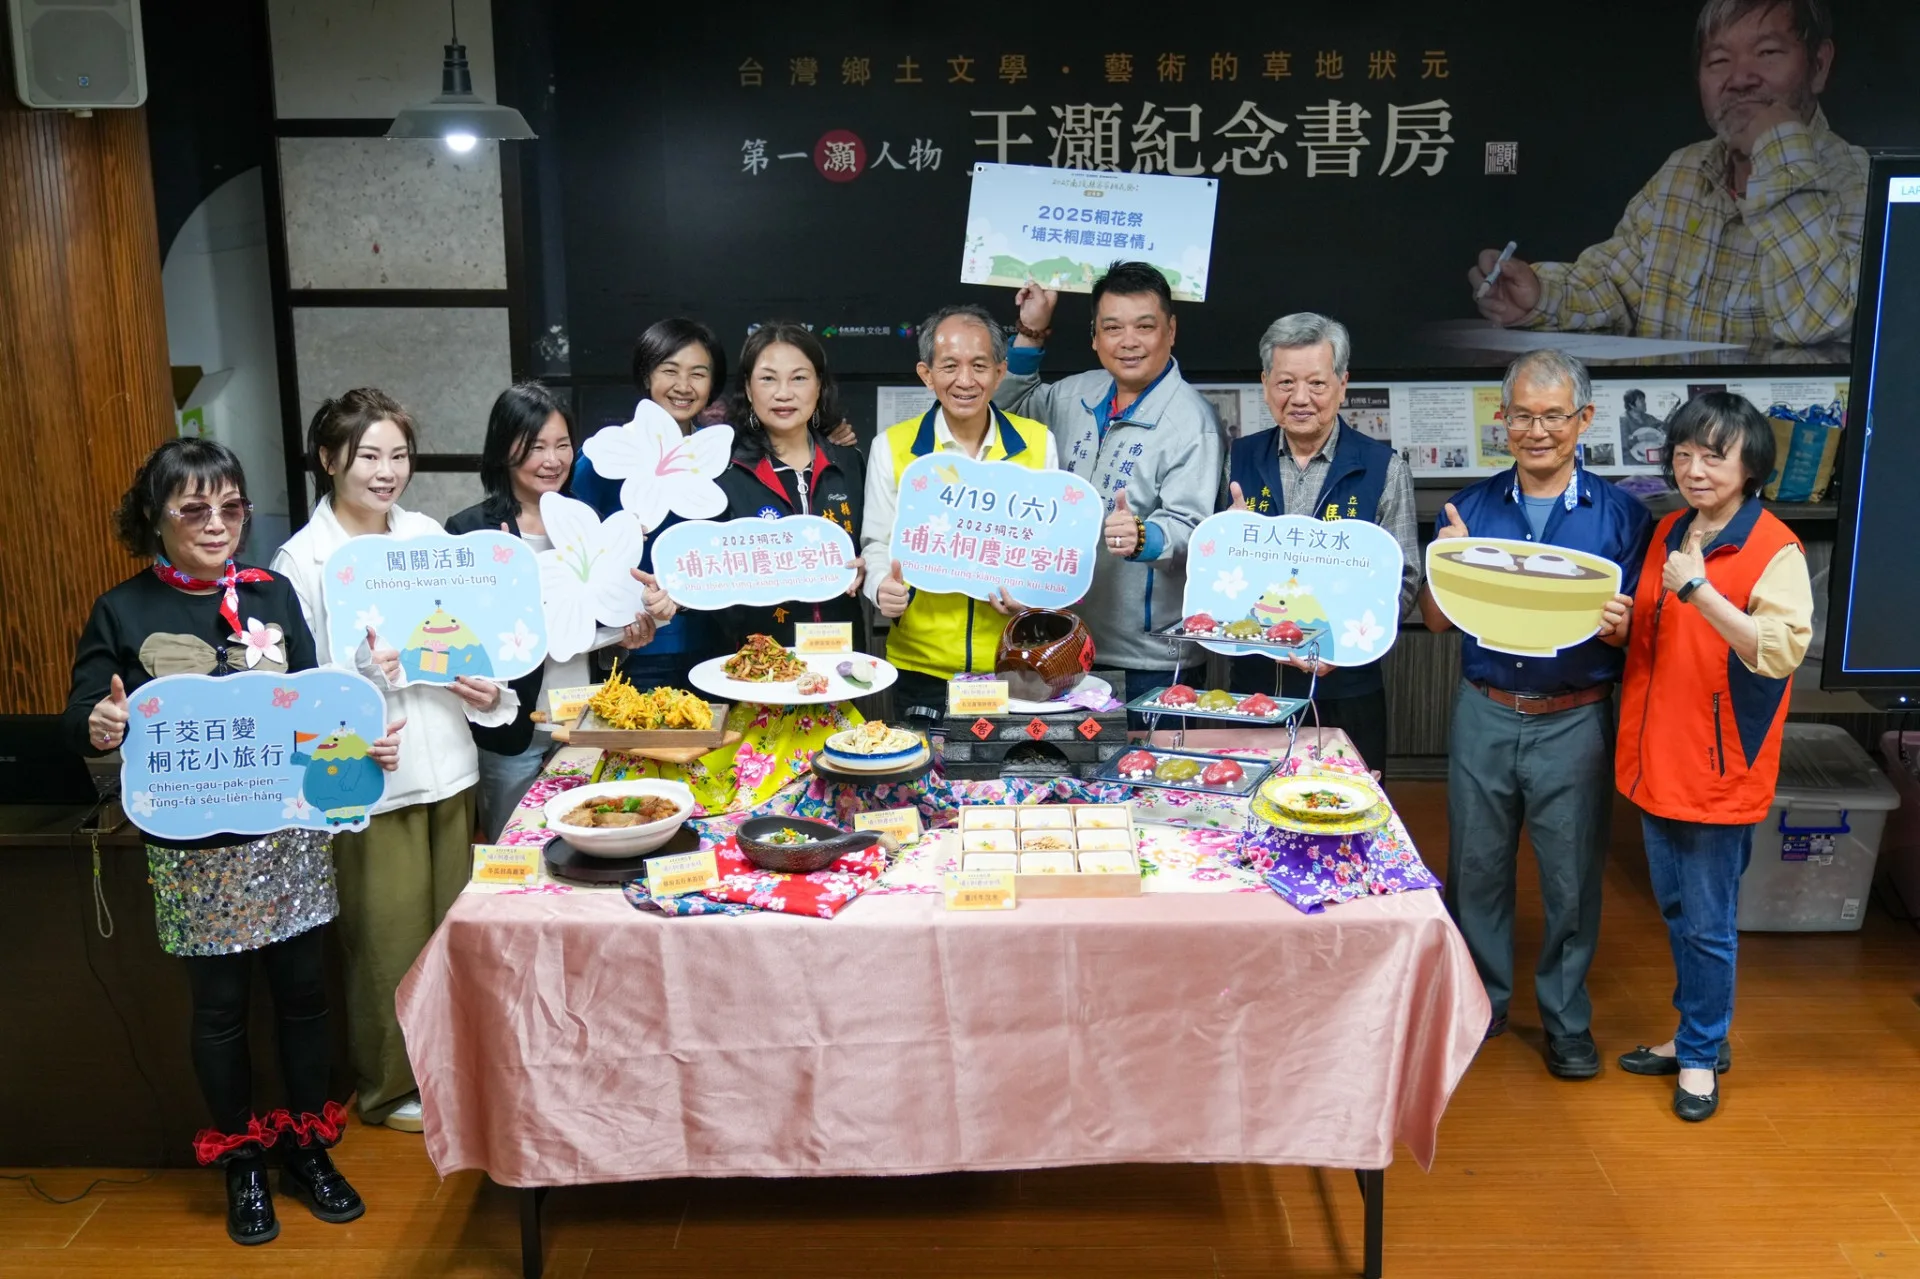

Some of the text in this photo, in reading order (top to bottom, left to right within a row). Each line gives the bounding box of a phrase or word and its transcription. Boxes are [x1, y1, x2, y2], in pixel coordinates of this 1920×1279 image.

[967, 99, 1455, 178] 王灝紀念書房
[741, 138, 943, 176] 第一灝人物
[1038, 205, 1144, 228] 2025桐花祭
[1347, 495, 1358, 517] 立法
[722, 531, 793, 547] 2025桐花祭
[957, 517, 1034, 541] 2025桐花祭
[1243, 523, 1350, 551] 百人牛汶水
[387, 547, 475, 571] 闖關活動
[676, 542, 844, 578] 埔天桐慶迎客情
[902, 525, 1080, 575] 埔天桐慶迎客情
[146, 716, 256, 745] 千茭百變
[147, 744, 284, 774] 桐花小旅行
[148, 777, 274, 794] Chhien-gau-pak-pien
[149, 795, 196, 809] Tùng-fà
